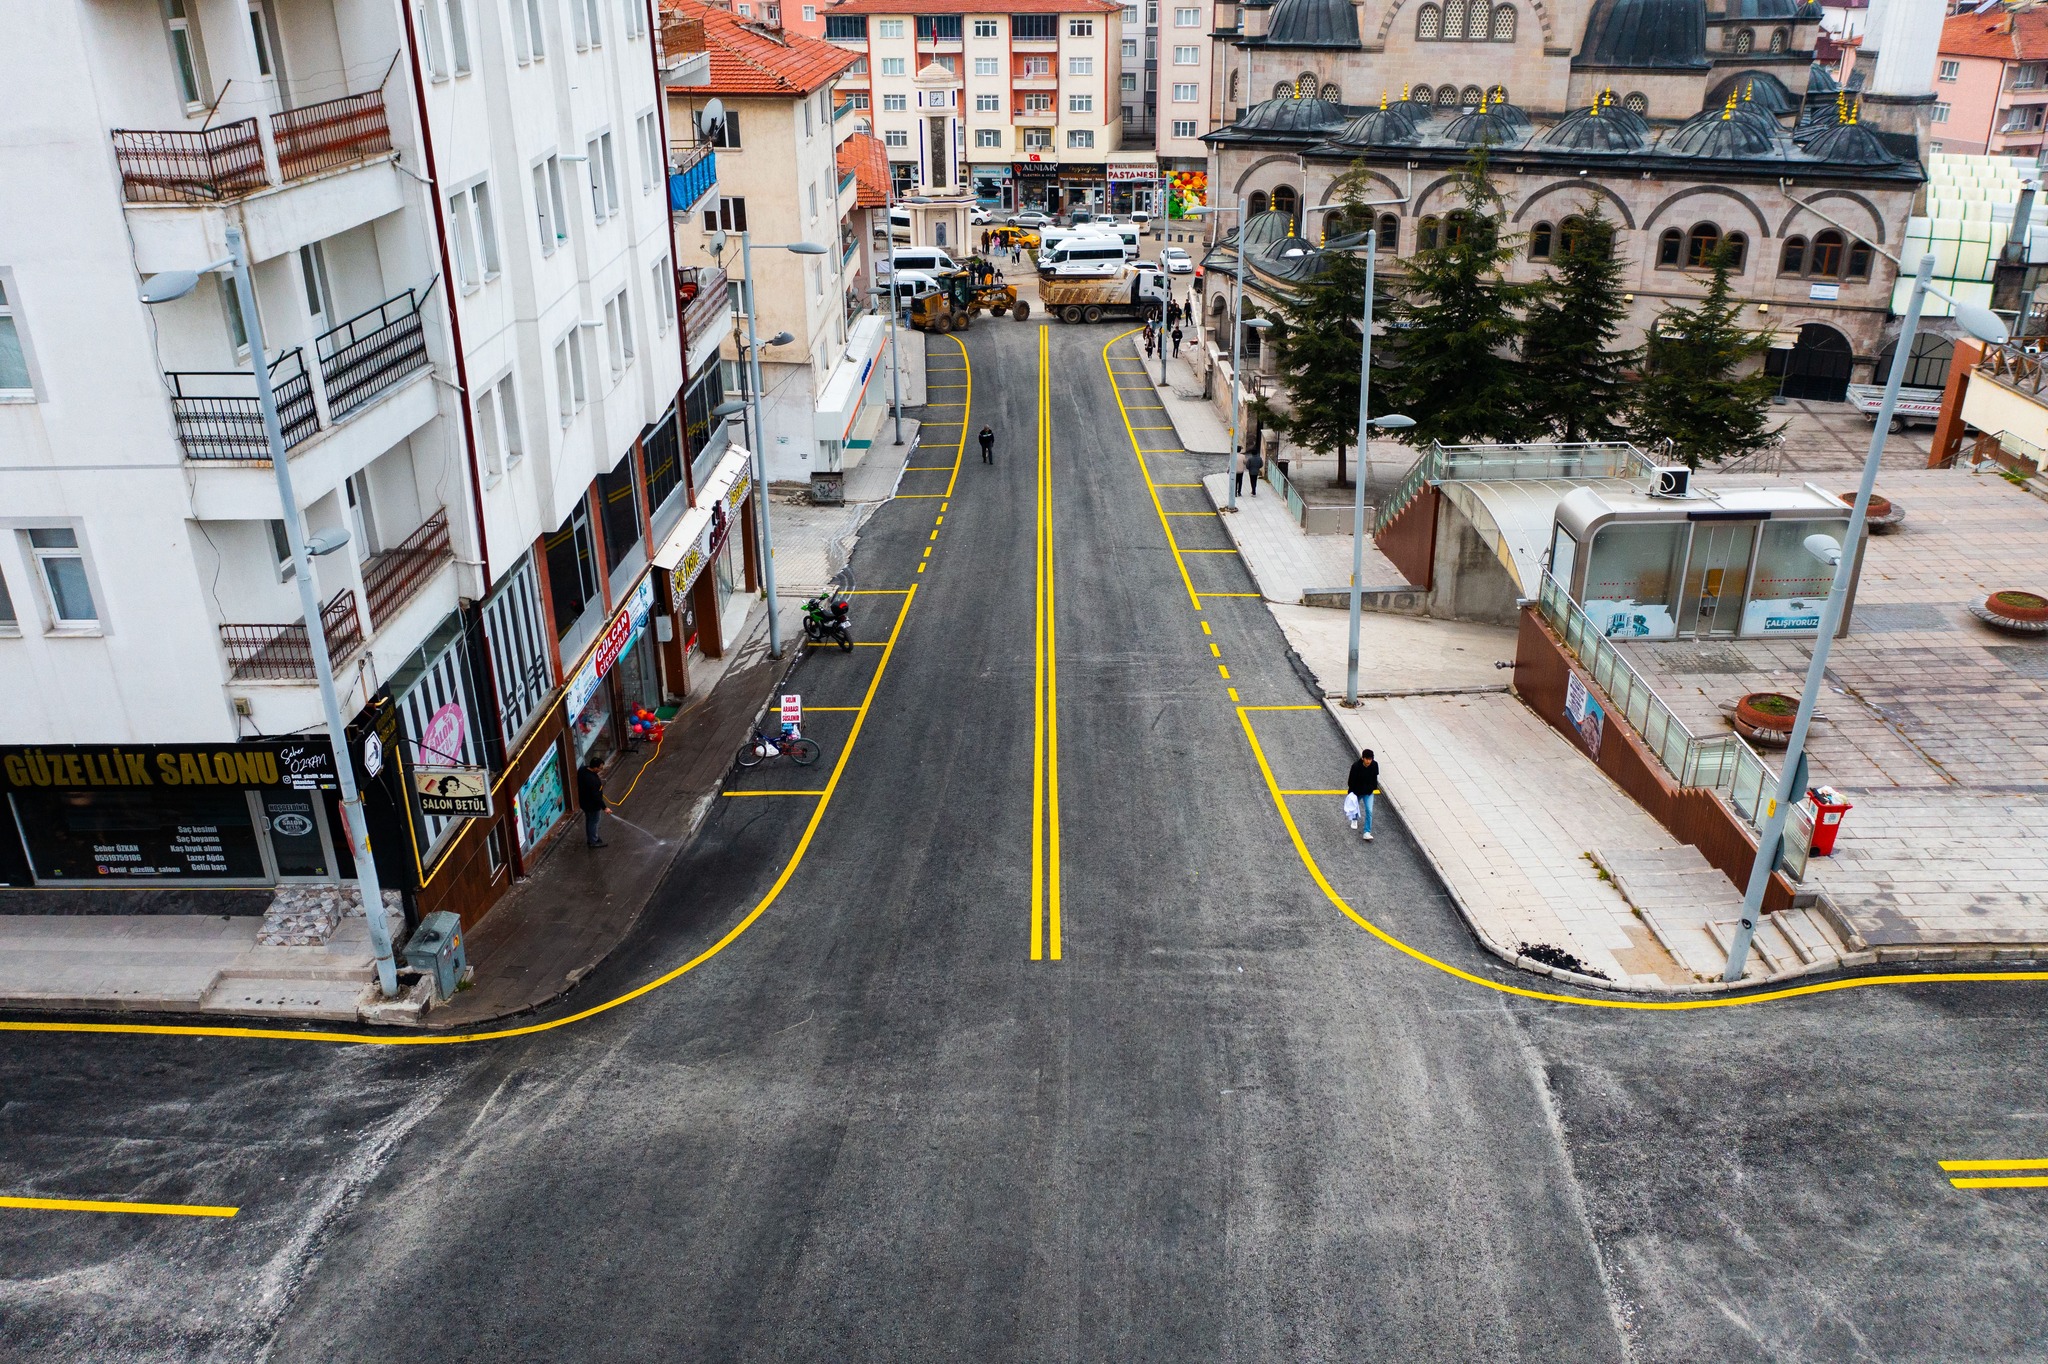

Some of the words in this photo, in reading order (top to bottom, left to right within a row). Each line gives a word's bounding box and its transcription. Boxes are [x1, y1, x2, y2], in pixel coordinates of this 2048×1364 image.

[1108, 170, 1157, 179] PASTANESİ
[1766, 619, 1818, 629] ÇALIŞIYORUZ
[596, 611, 628, 662] GÜLCAN
[4, 748, 153, 787] GÜZELLİK
[156, 751, 279, 786] SALONU
[422, 798, 453, 810] SALON
[455, 797, 486, 811] BETÜL
[177, 825, 192, 834] Saç
[193, 825, 218, 833] kesimi
[176, 835, 190, 844] Saç
[191, 835, 220, 844] boyama
[93, 844, 115, 852] Seher
[115, 843, 139, 852] ÖZKAN
[170, 845, 184, 853] Kaş
[186, 854, 205, 862] Lazer
[206, 854, 225, 863] Ağda
[191, 863, 211, 871] Gelin
[211, 863, 227, 872] başı
